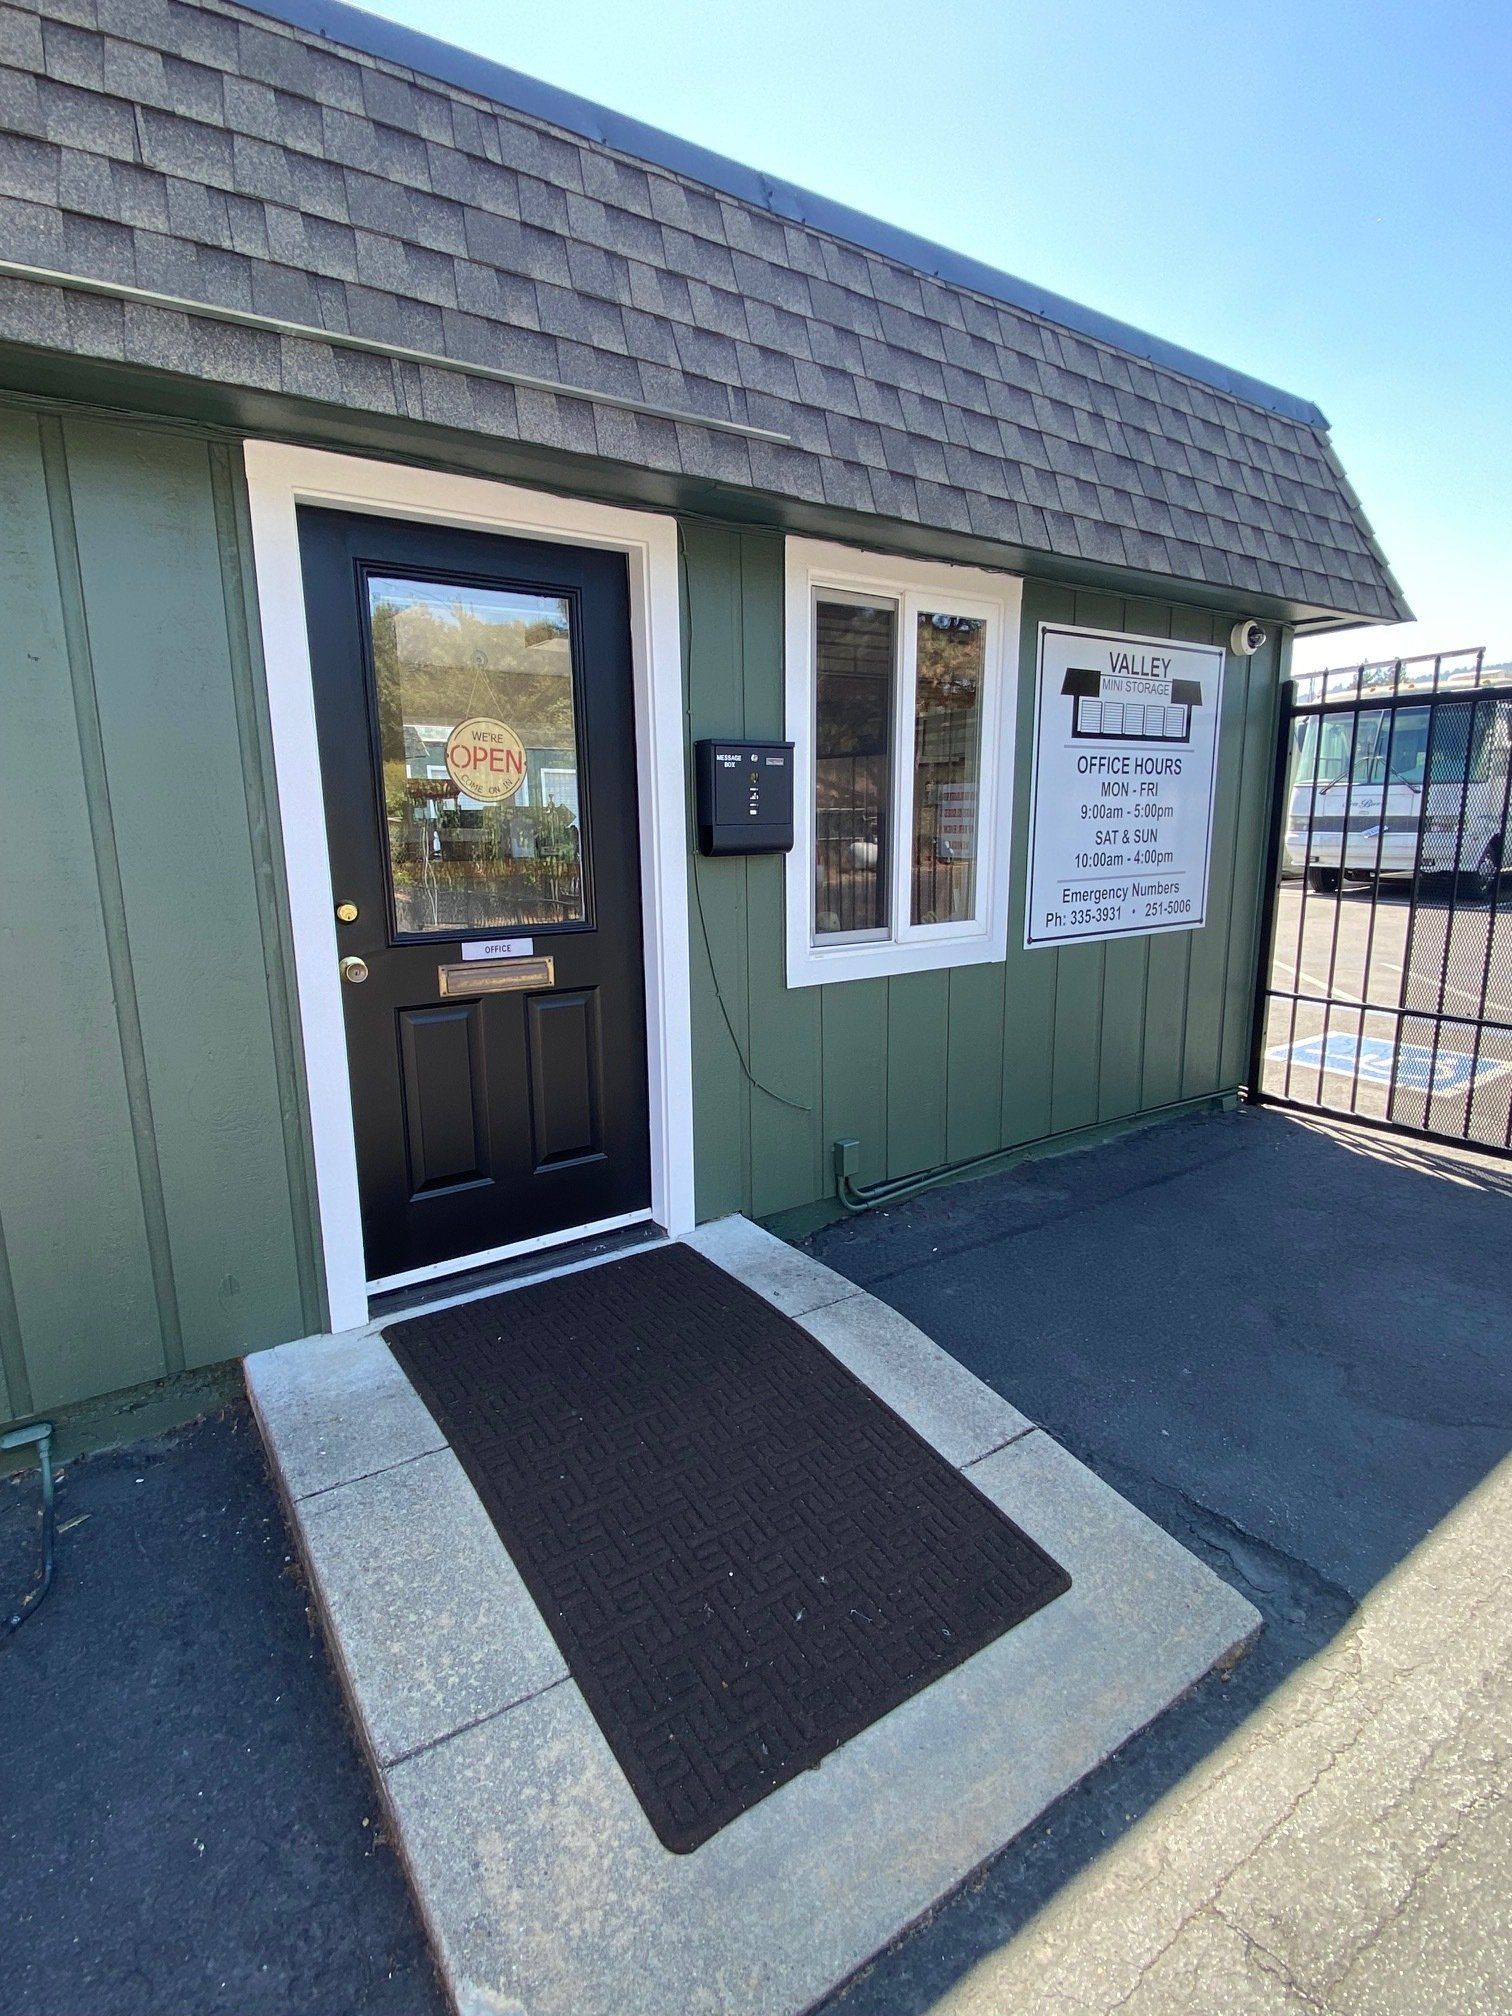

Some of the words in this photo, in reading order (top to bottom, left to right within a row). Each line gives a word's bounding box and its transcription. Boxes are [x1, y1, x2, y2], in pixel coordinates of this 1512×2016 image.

[1110, 651, 1172, 678] VALLEY
[1102, 678, 1123, 691] MINI
[1125, 681, 1170, 695] STORAGE
[472, 731, 503, 743] WE'RE
[450, 745, 522, 774] OPEN
[1077, 755, 1130, 774] OFFICE
[1134, 757, 1182, 775] HOURS
[461, 774, 483, 793] COME
[488, 786, 500, 794] ON
[503, 778, 513, 789] IN
[1101, 782, 1129, 796] MON
[1140, 782, 1158, 796] FRI
[1081, 804, 1123, 819] 9:00am
[1134, 803, 1174, 821] 5:00pm
[1095, 830, 1119, 845] SAT
[1122, 829, 1130, 844] &
[1133, 828, 1158, 843] SUN
[1075, 852, 1123, 868] 10:00am
[1134, 849, 1173, 867] 4:00pm
[1062, 887, 1128, 904] Emergency
[1132, 881, 1180, 897] Numbers
[1046, 912, 1066, 928] Ph:
[1070, 906, 1121, 925] 335-3931
[1145, 899, 1191, 917] 251-5006
[484, 944, 511, 954] OFFICE
